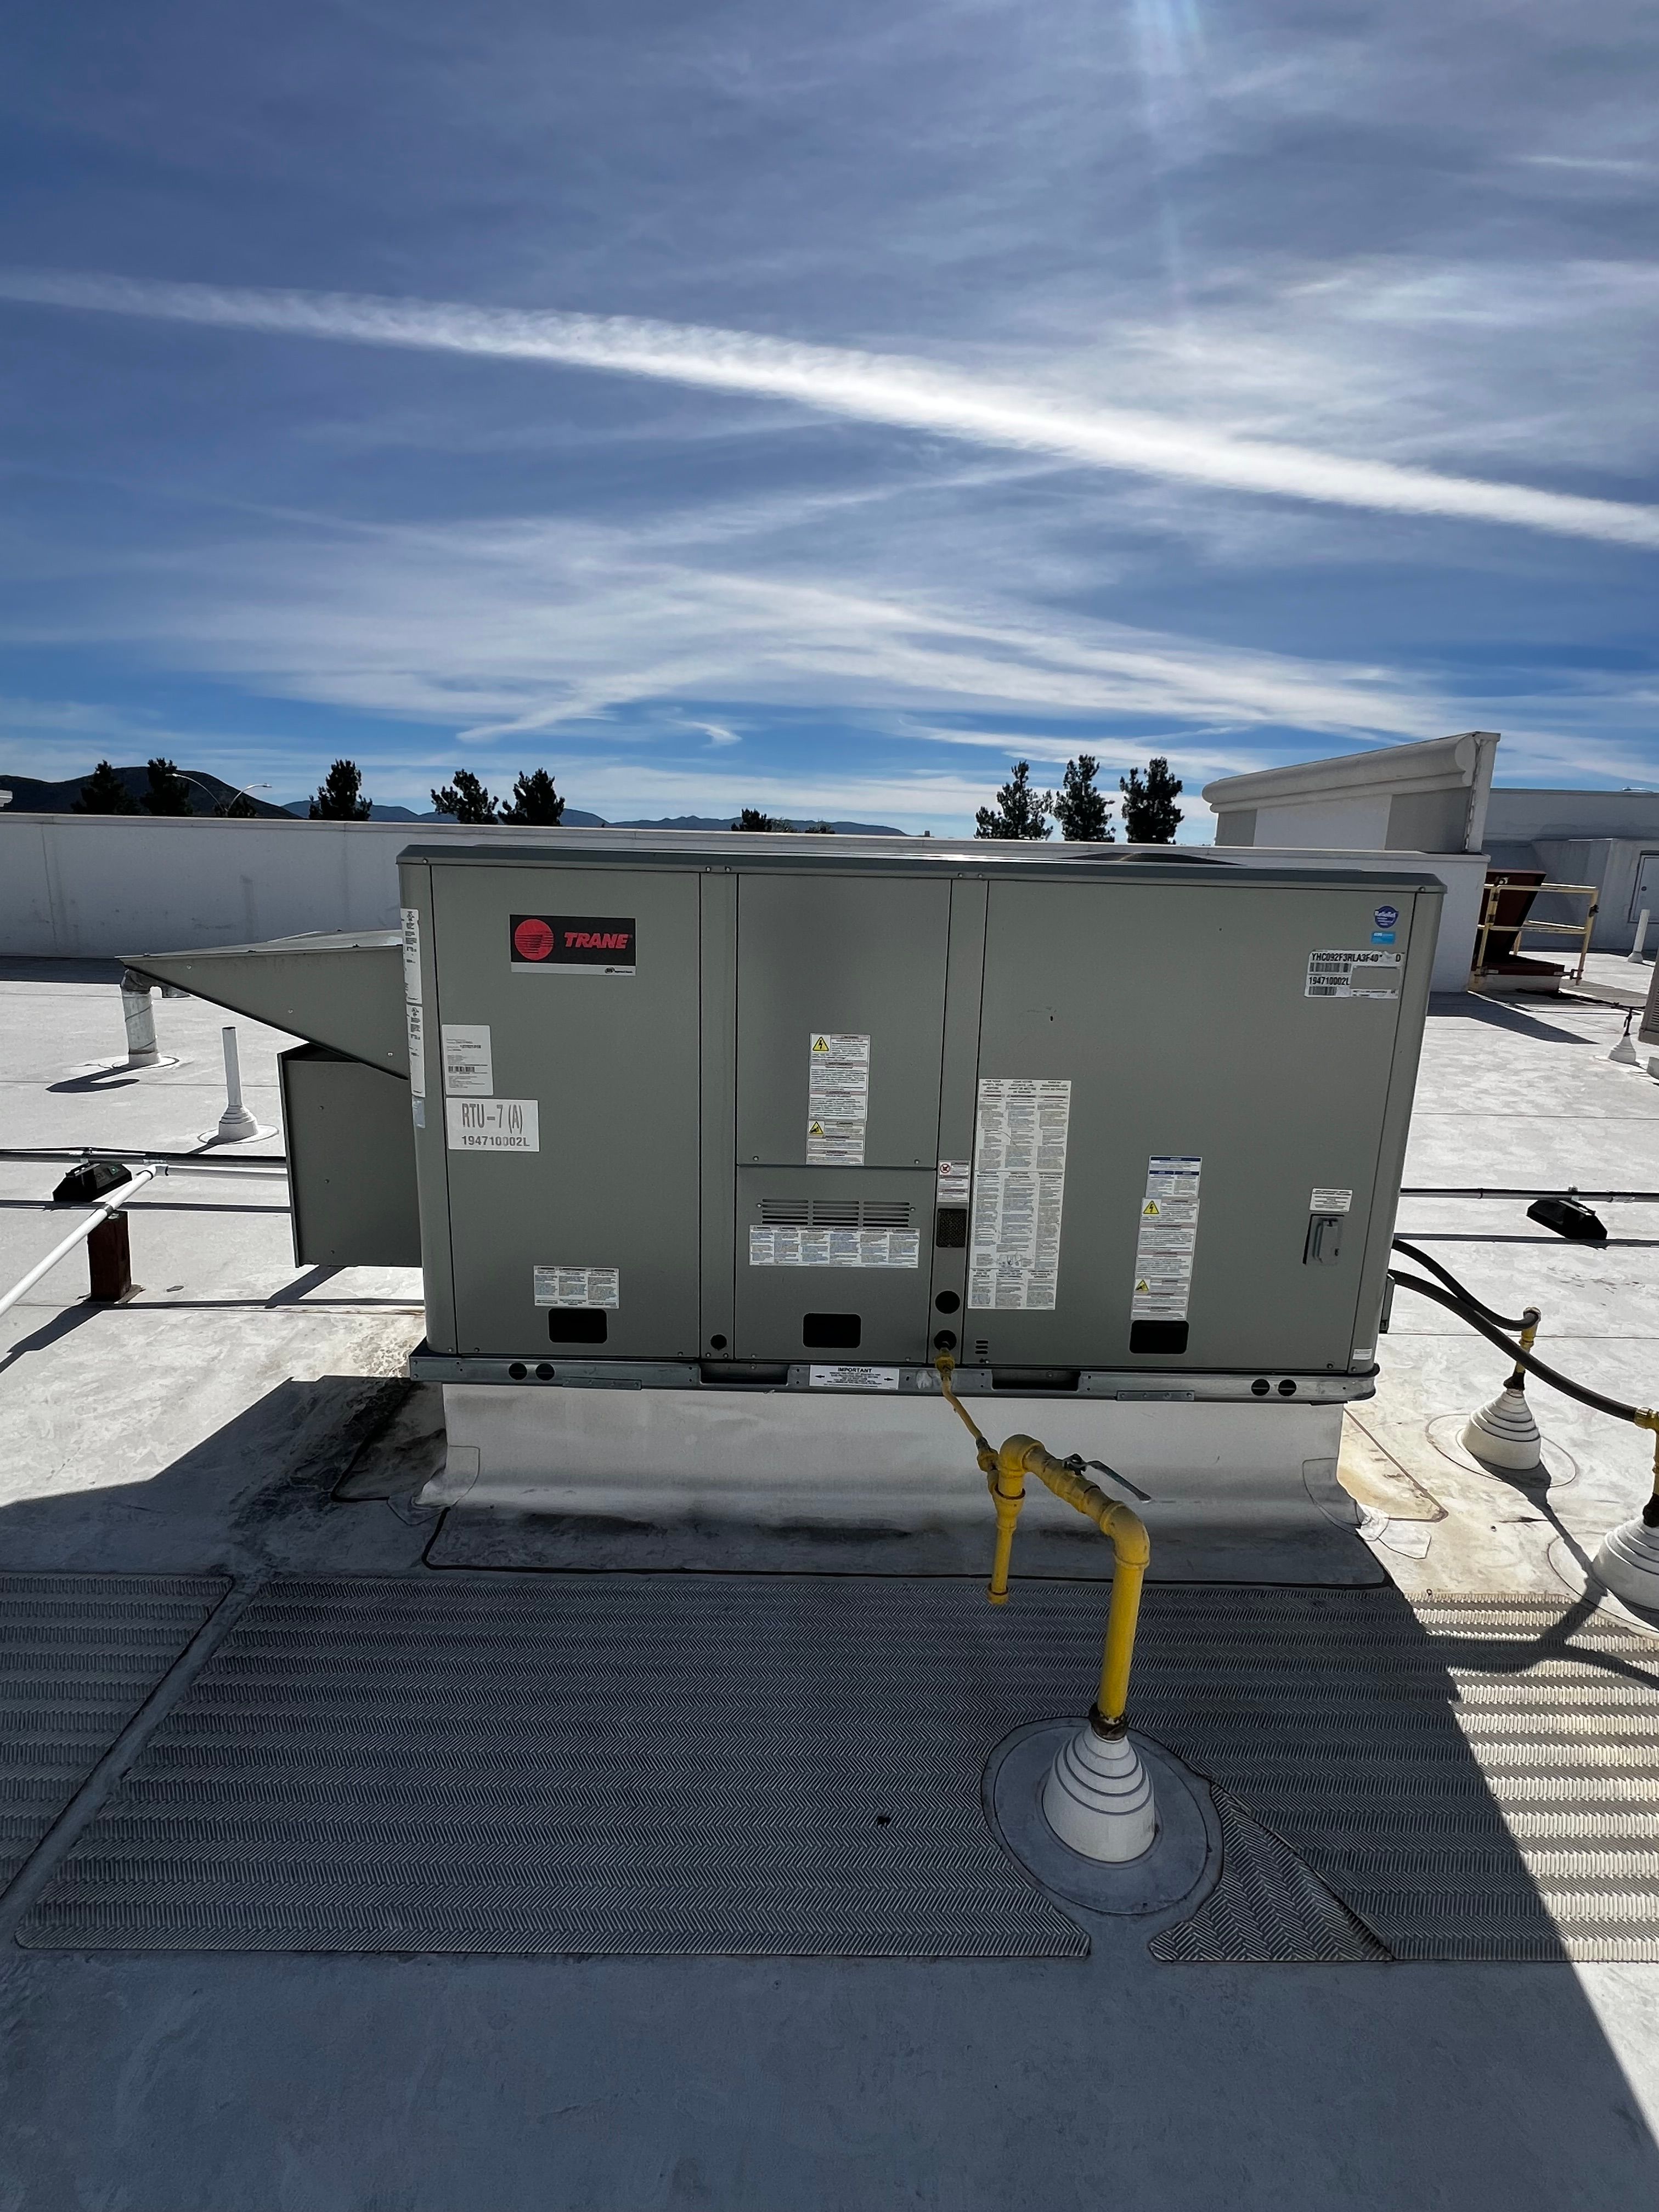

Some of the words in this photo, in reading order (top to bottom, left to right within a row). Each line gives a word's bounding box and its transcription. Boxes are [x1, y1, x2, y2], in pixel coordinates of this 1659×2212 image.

[564, 932, 629, 949] TRANE
[1309, 977, 1350, 985] 194710002L
[508, 1104, 523, 1134] (A)
[461, 1136, 530, 1147] 194710002L
